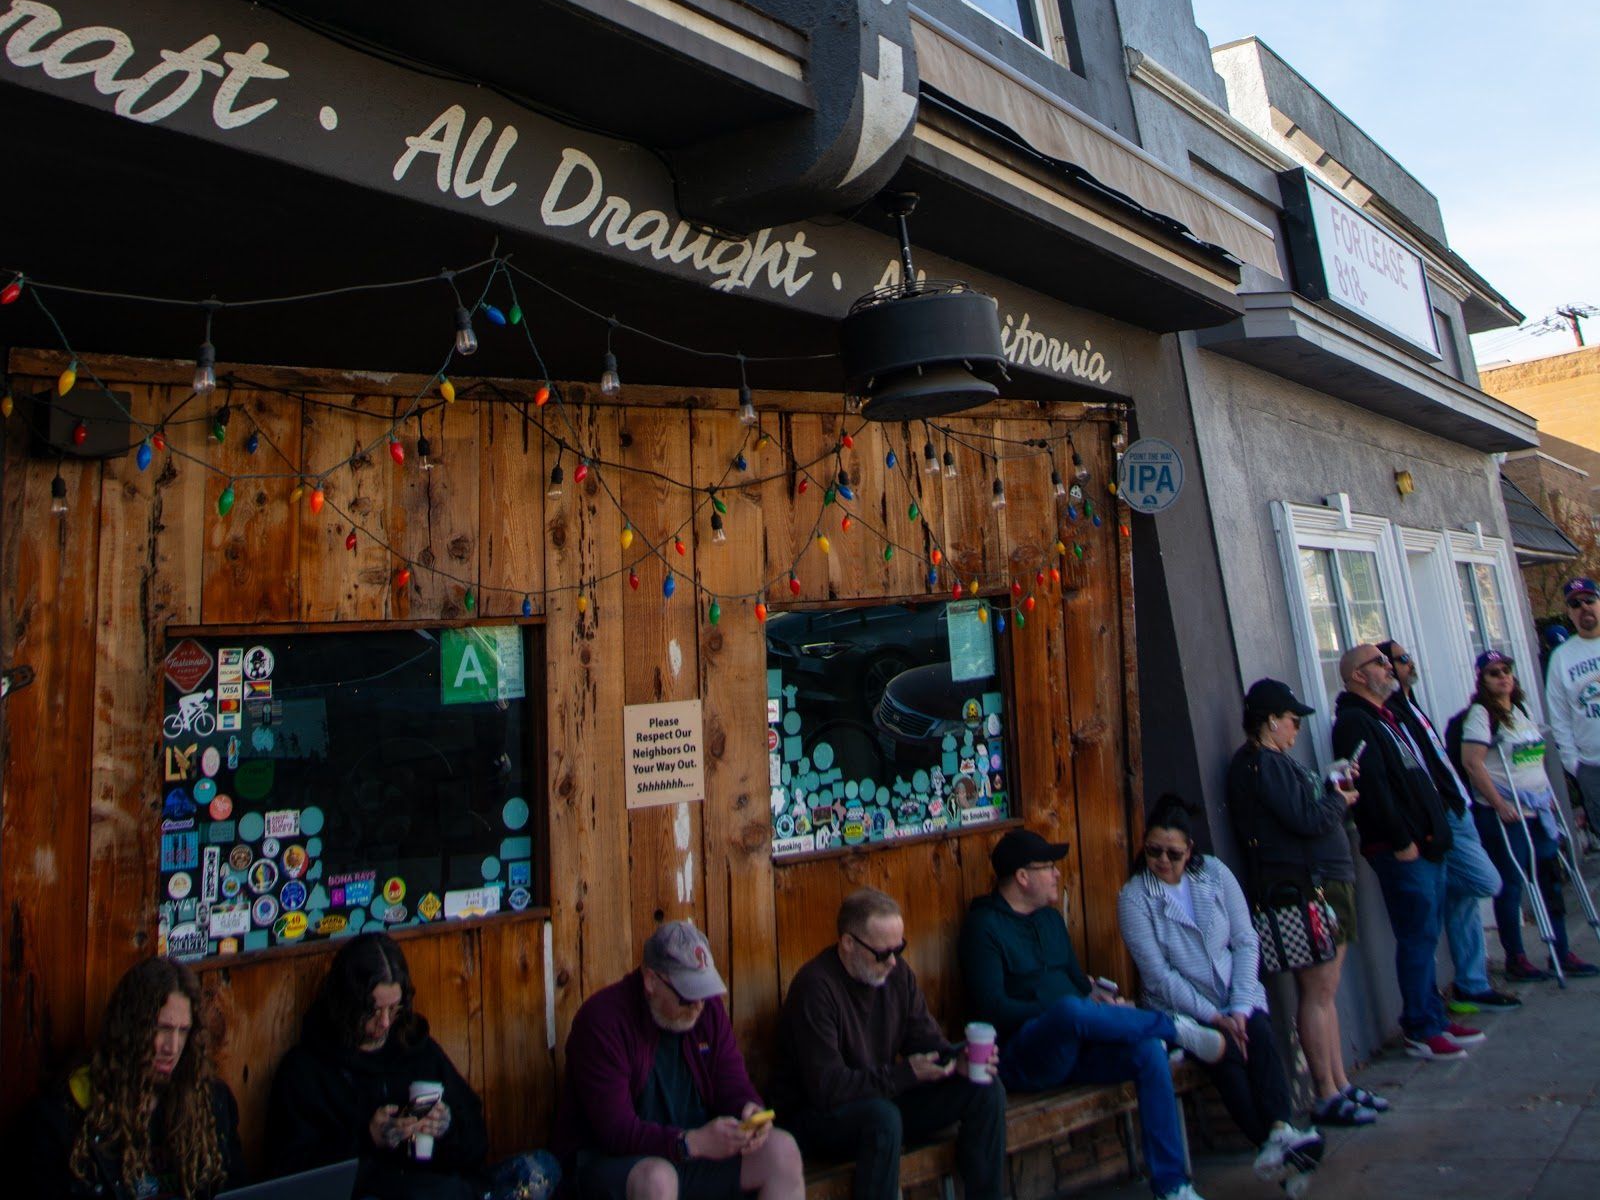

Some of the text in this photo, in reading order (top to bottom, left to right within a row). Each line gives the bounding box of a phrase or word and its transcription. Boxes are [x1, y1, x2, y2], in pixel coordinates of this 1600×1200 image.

[392, 104, 518, 207] All
[540, 147, 817, 298] Draught
[1330, 206, 1409, 290] FOR LEASE
[1129, 464, 1175, 494] IPA
[453, 644, 488, 688] A
[222, 686, 239, 694] VISA
[649, 718, 679, 728] Please
[636, 729, 692, 743] Respect Our
[633, 744, 696, 759] Neighbors On
[633, 760, 697, 774] Your Way Out.
